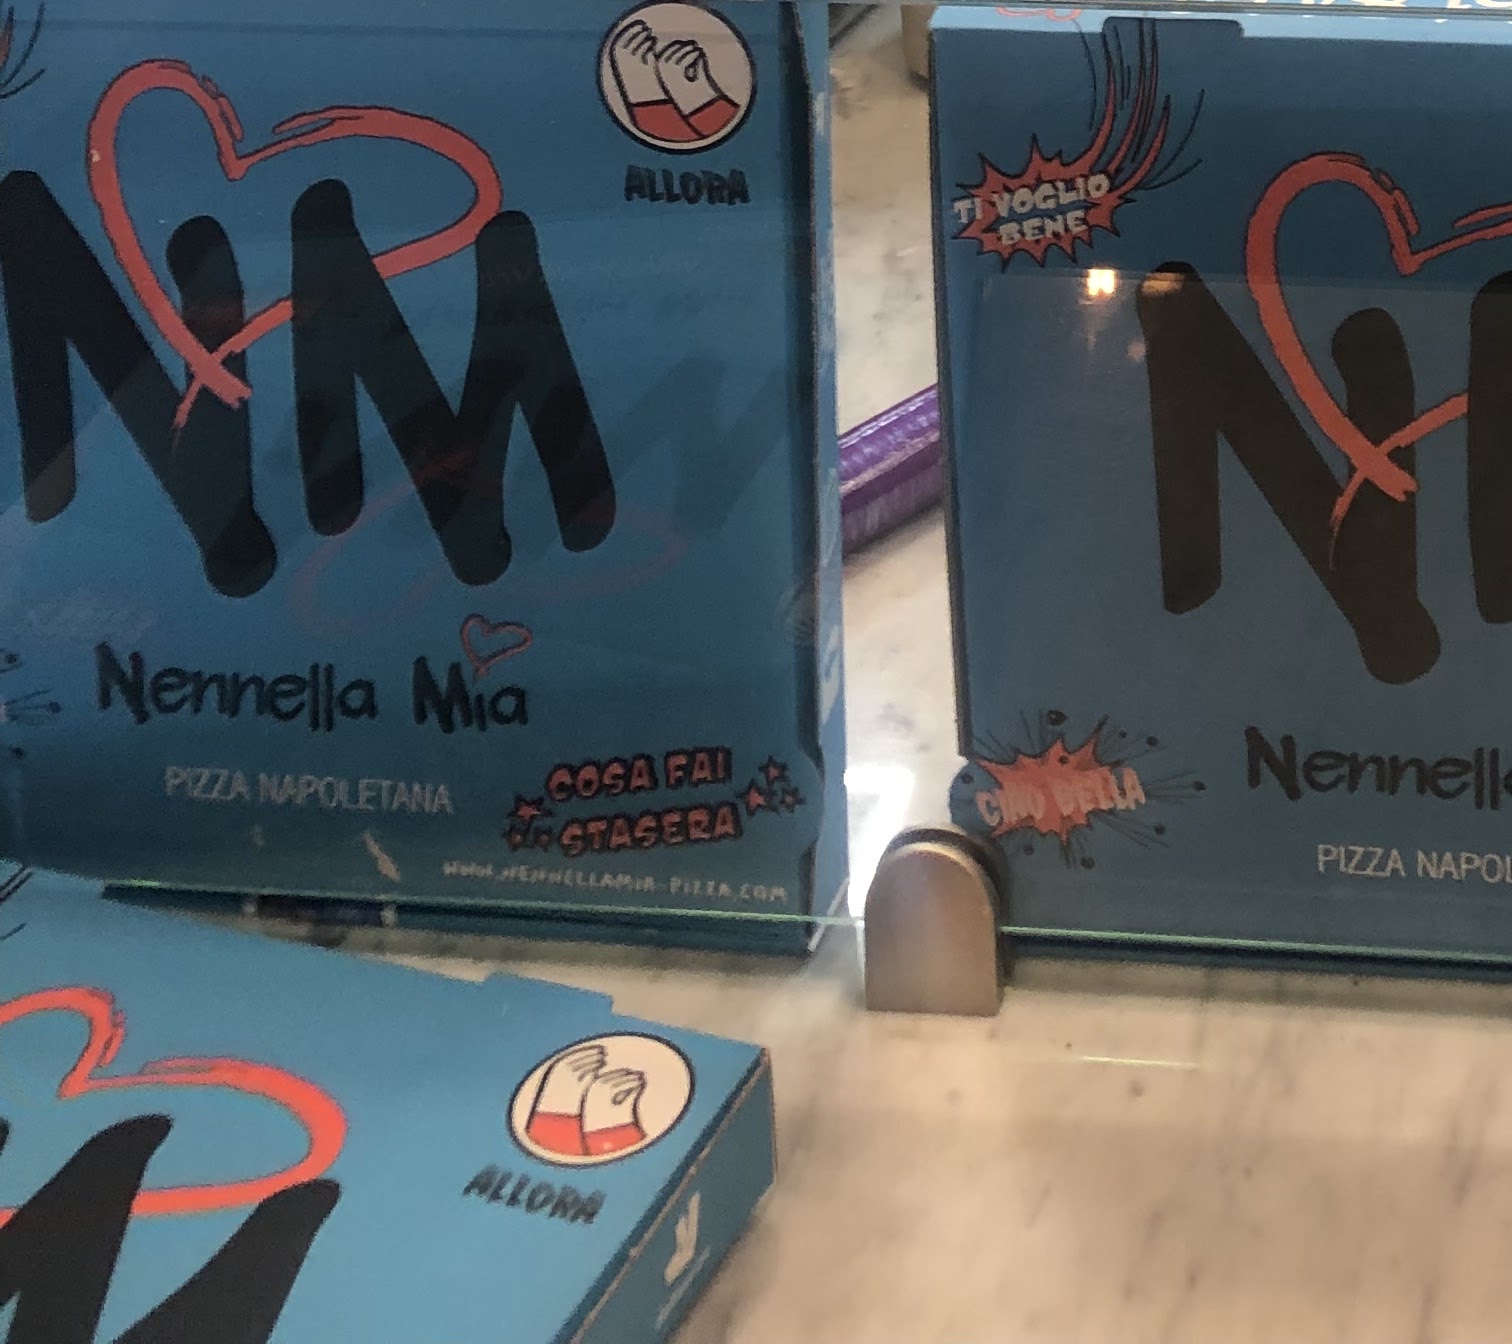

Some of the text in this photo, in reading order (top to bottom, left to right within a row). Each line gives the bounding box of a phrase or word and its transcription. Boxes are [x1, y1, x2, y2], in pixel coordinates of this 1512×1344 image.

[623, 166, 750, 206] ALLORA
[953, 173, 1110, 224] TI VOGLIO
[998, 209, 1089, 246] BENE
[0, 169, 616, 598] NM
[95, 640, 529, 734] Nennella Mia
[164, 765, 454, 814] PIZZA NAPOLETANA
[545, 745, 733, 803] COSA FAI
[557, 800, 744, 858] STASERA
[1316, 843, 1407, 878] PIZZA
[463, 1164, 608, 1226] ALLORA
